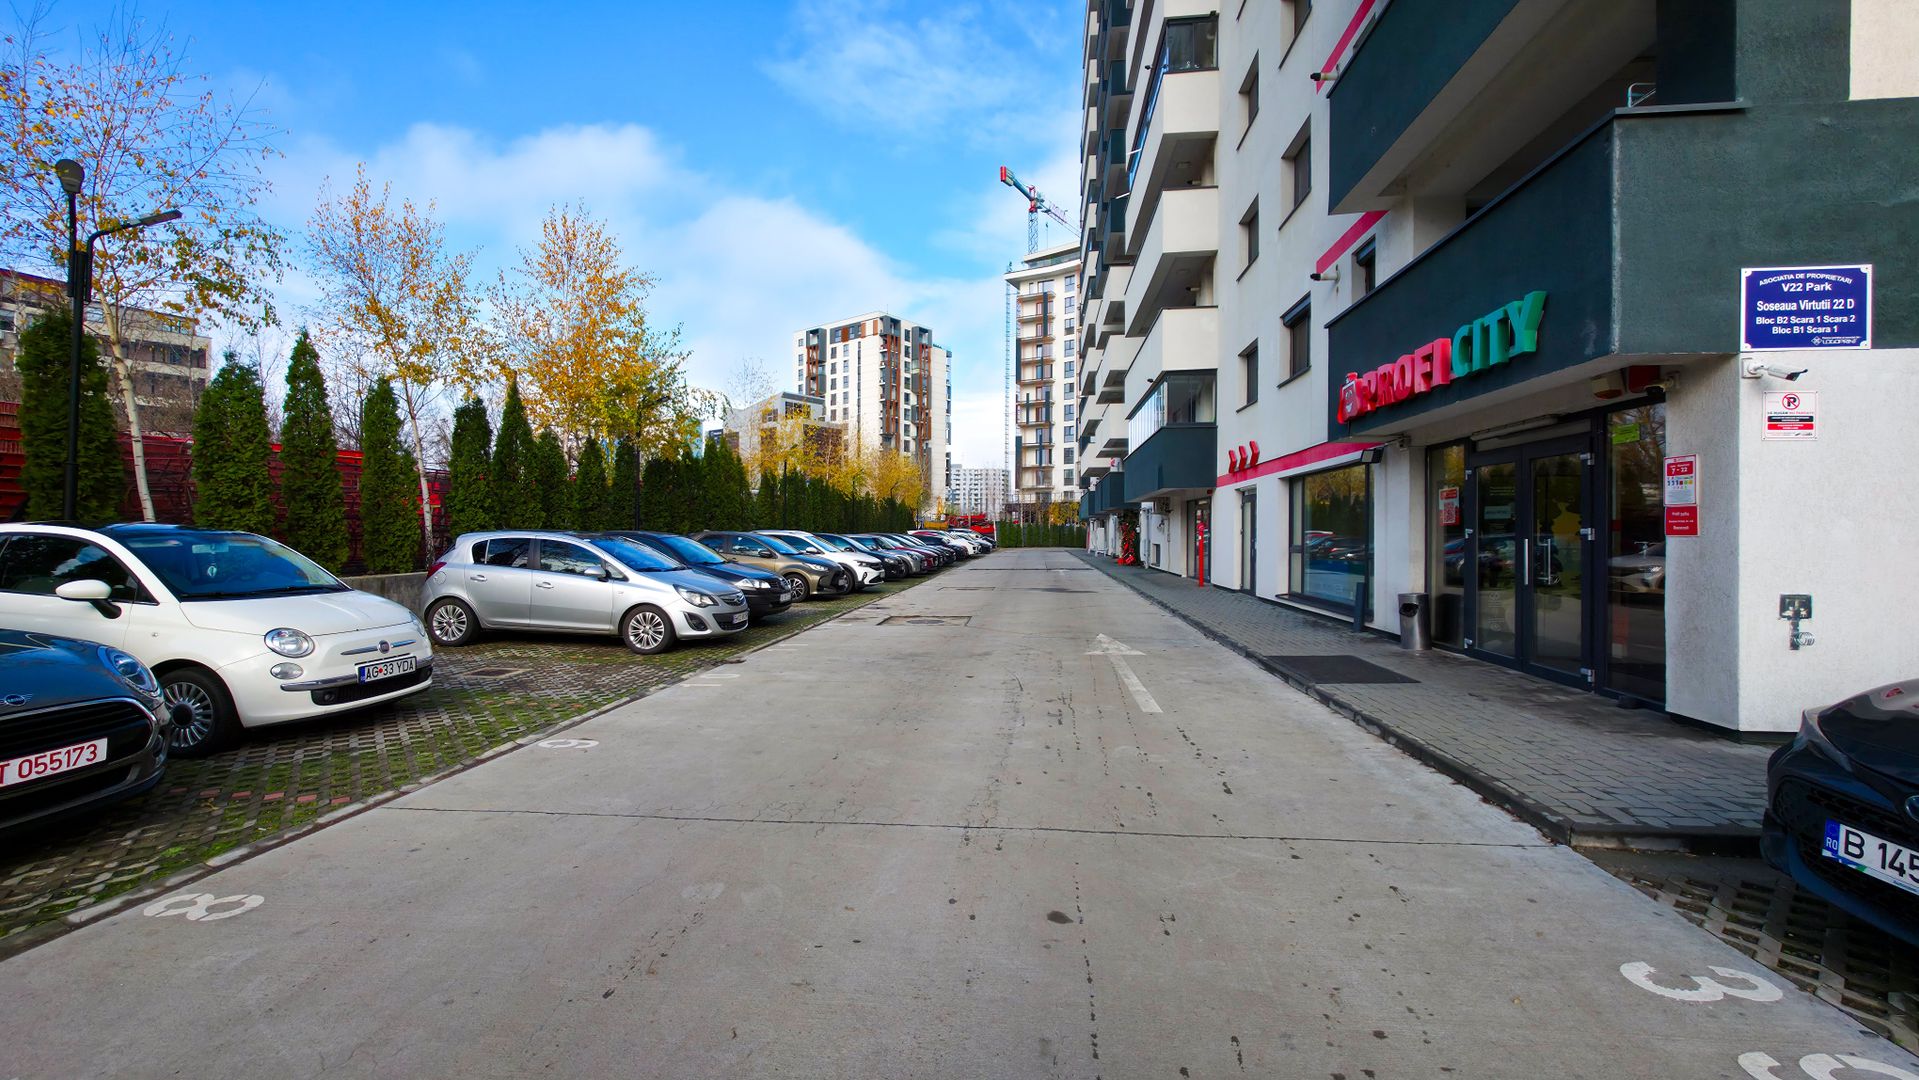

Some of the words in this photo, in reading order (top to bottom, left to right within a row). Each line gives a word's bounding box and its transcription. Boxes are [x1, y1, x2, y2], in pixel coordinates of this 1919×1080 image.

[1759, 273, 1795, 286] ASOCIATIA
[1806, 273, 1853, 285] PROPRIETARI
[1782, 283, 1803, 292] V22
[1806, 282, 1832, 292] Park
[1756, 301, 1797, 311] Soseaua
[1799, 299, 1831, 311] Virtutii
[1833, 300, 1845, 310] 22
[1847, 299, 1855, 309] D
[1756, 316, 1775, 325] Bloc
[1777, 316, 1788, 325] B2
[1790, 316, 1814, 325] Scara
[1823, 315, 1847, 323] Scara
[1849, 315, 1856, 323] 2
[1772, 326, 1791, 335] Bloc
[1793, 326, 1804, 334] B1
[1806, 326, 1831, 334] Scara
[1361, 338, 1451, 412] PROFI
[1452, 291, 1547, 378] CITY
[366, 666, 379, 680] AG
[383, 663, 394, 676] 33
[396, 660, 414, 673] YDA
[18, 743, 98, 779] 055173
[1825, 837, 1838, 851] RO
[1844, 829, 1865, 860] B
[143, 893, 265, 921] 8
